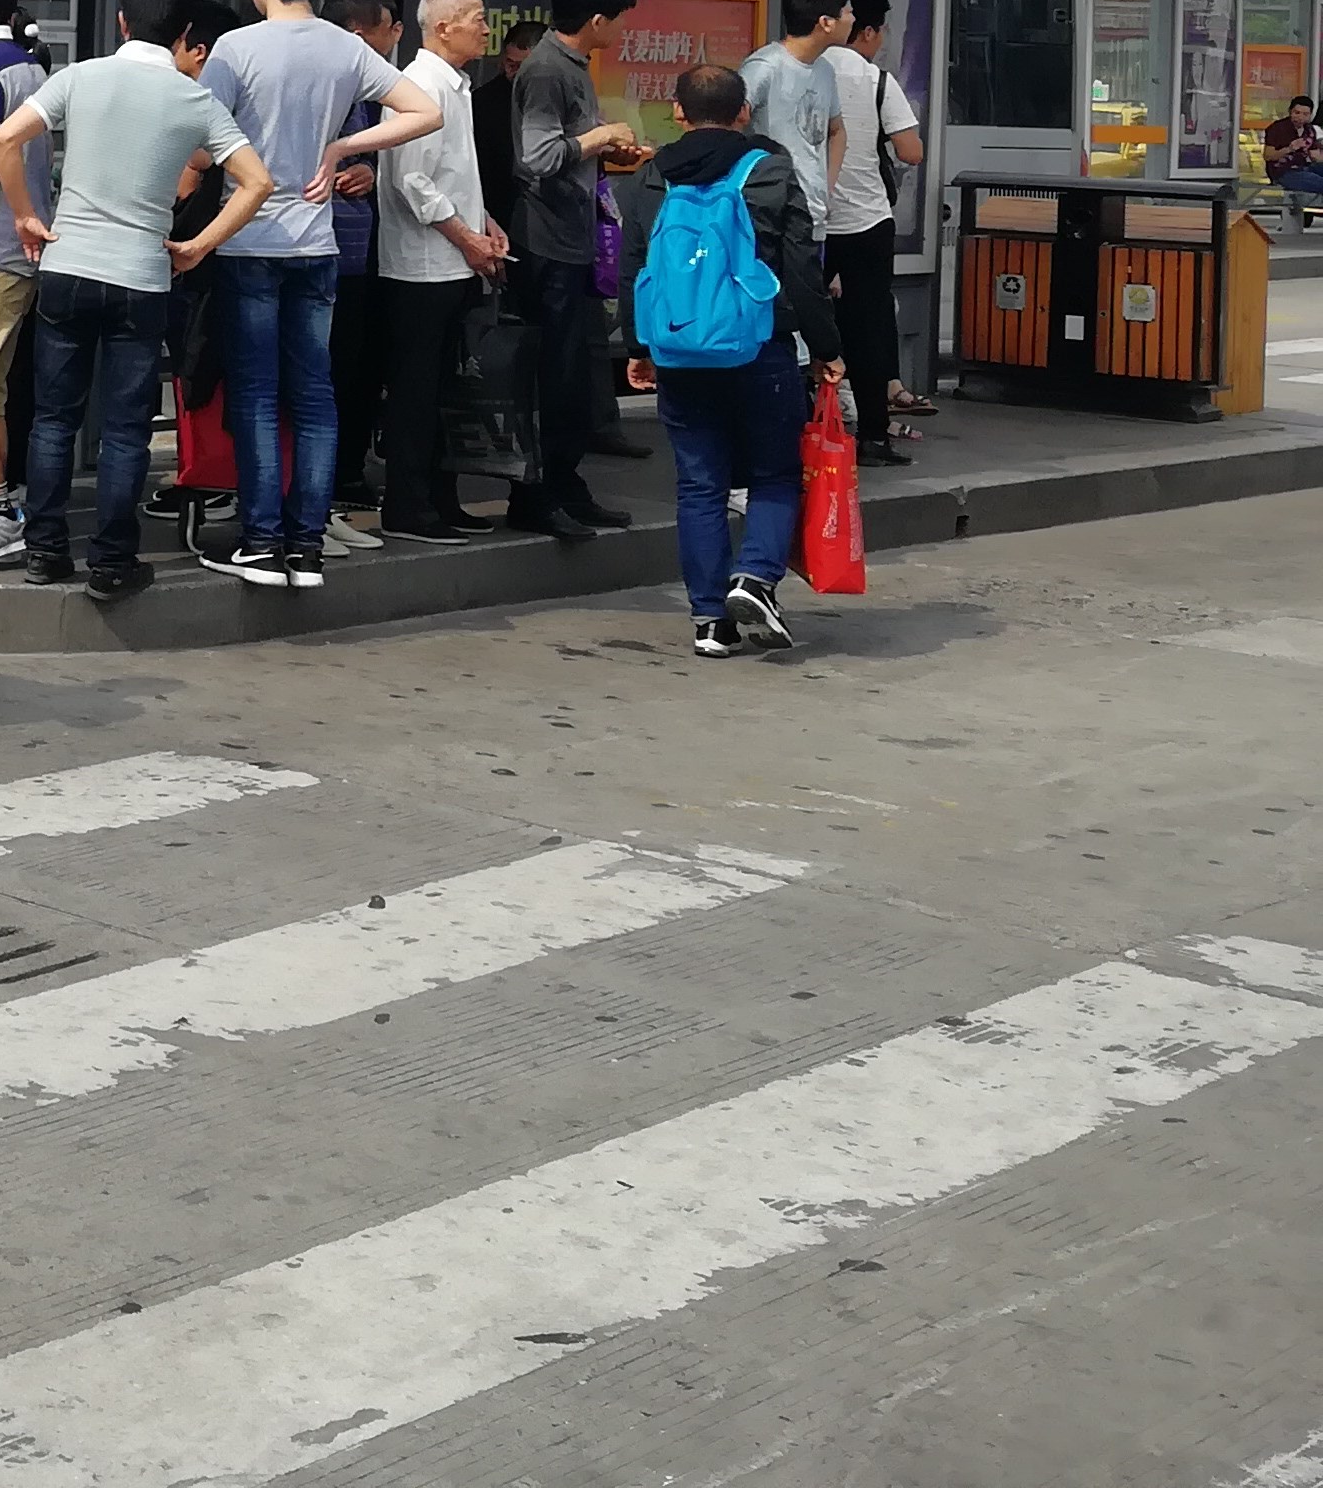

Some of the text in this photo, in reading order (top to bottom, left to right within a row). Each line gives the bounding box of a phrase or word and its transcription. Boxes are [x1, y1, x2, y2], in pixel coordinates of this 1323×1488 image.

[486, 5, 552, 56] 时
[617, 29, 708, 64] 关爱未成年人
